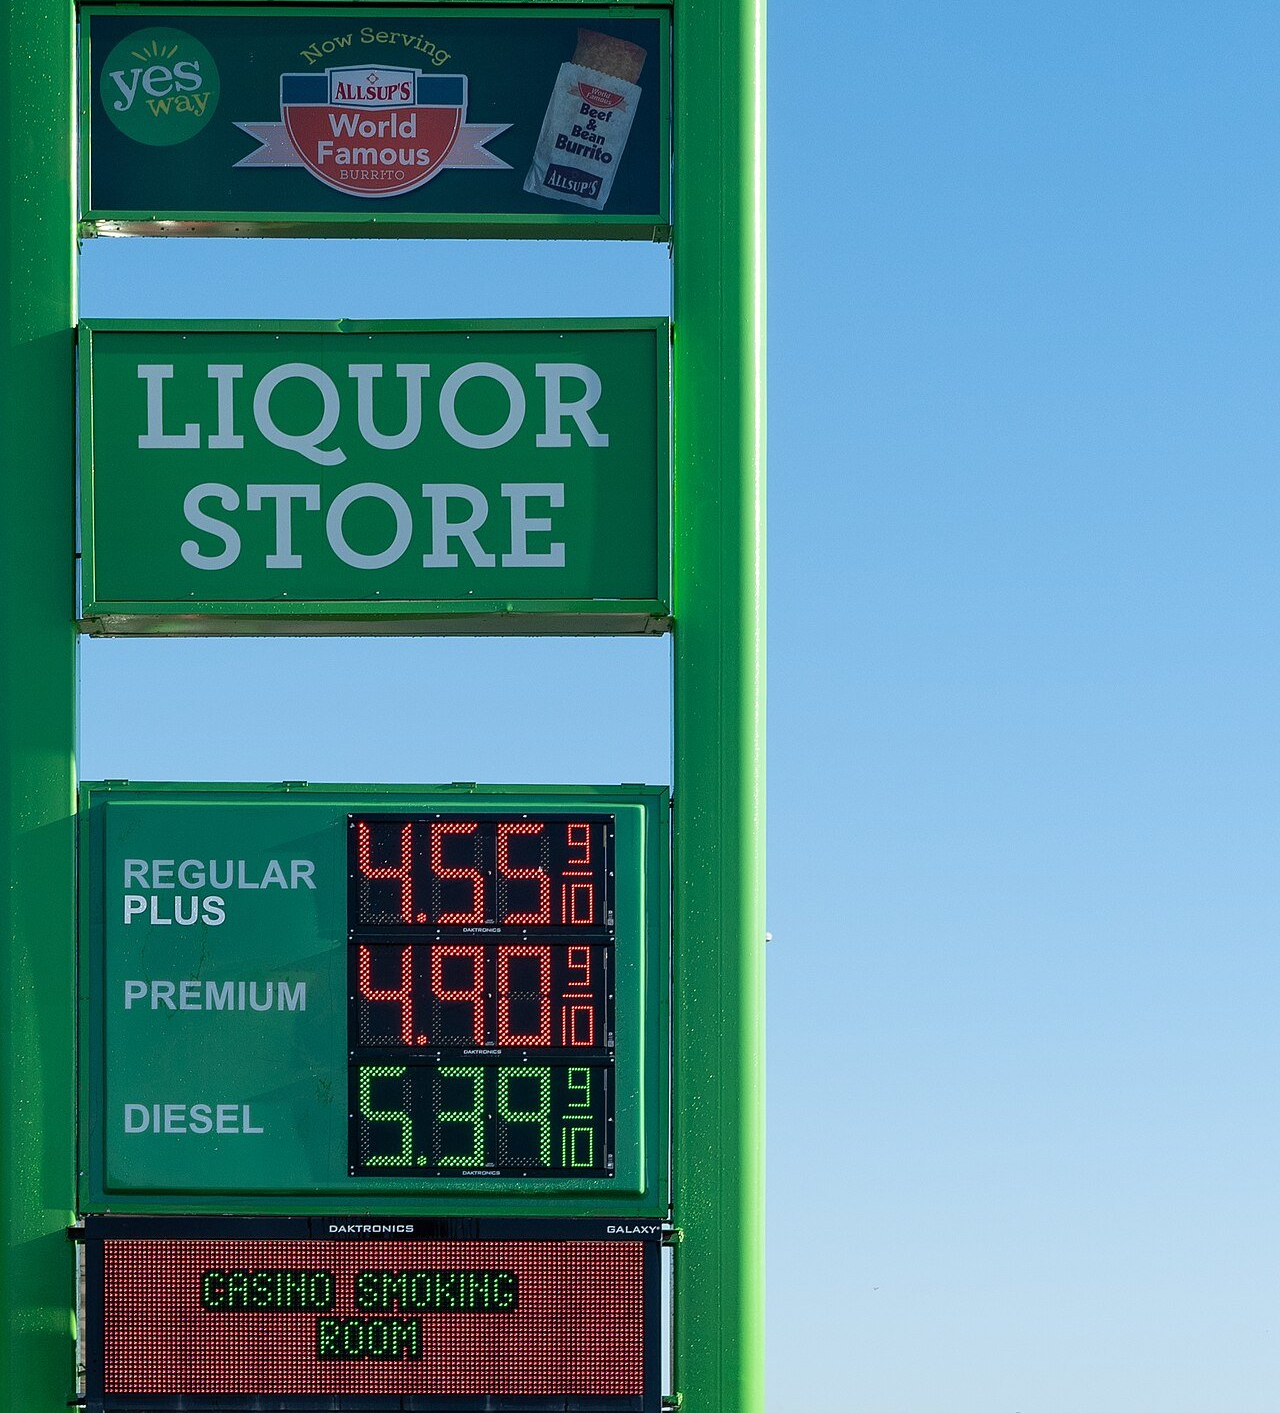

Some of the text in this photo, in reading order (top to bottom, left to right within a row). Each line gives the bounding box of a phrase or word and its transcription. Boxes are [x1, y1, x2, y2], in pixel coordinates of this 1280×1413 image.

[299, 27, 452, 66] Now Serving
[109, 60, 203, 112] yes
[334, 81, 411, 101] ALLSUP'S
[585, 92, 613, 106] Famous
[590, 87, 612, 99] World
[145, 92, 211, 117] way
[579, 102, 614, 123] Beef
[328, 112, 417, 138] World
[570, 124, 606, 146] Bean
[586, 119, 598, 131] &
[317, 140, 430, 165] Famous
[554, 133, 613, 165] Burrito
[339, 169, 405, 181] BURRITO
[547, 169, 599, 196] ALLSUP'S
[137, 362, 609, 466] LIQUOR
[180, 482, 566, 571] STORE
[124, 859, 317, 890] REGULAR
[358, 822, 551, 924] 4.55
[124, 894, 226, 926] PLUS
[124, 980, 307, 1012] PREMIUM
[359, 945, 551, 1046] 4.90
[124, 1103, 264, 1134] DIESEL
[359, 1066, 551, 1167] 5.39
[328, 1224, 415, 1233] DAKTRONICS
[606, 1225, 657, 1234] GALAXY
[202, 1272, 515, 1308] CASINO SMOKING
[318, 1319, 419, 1356] ROOM
